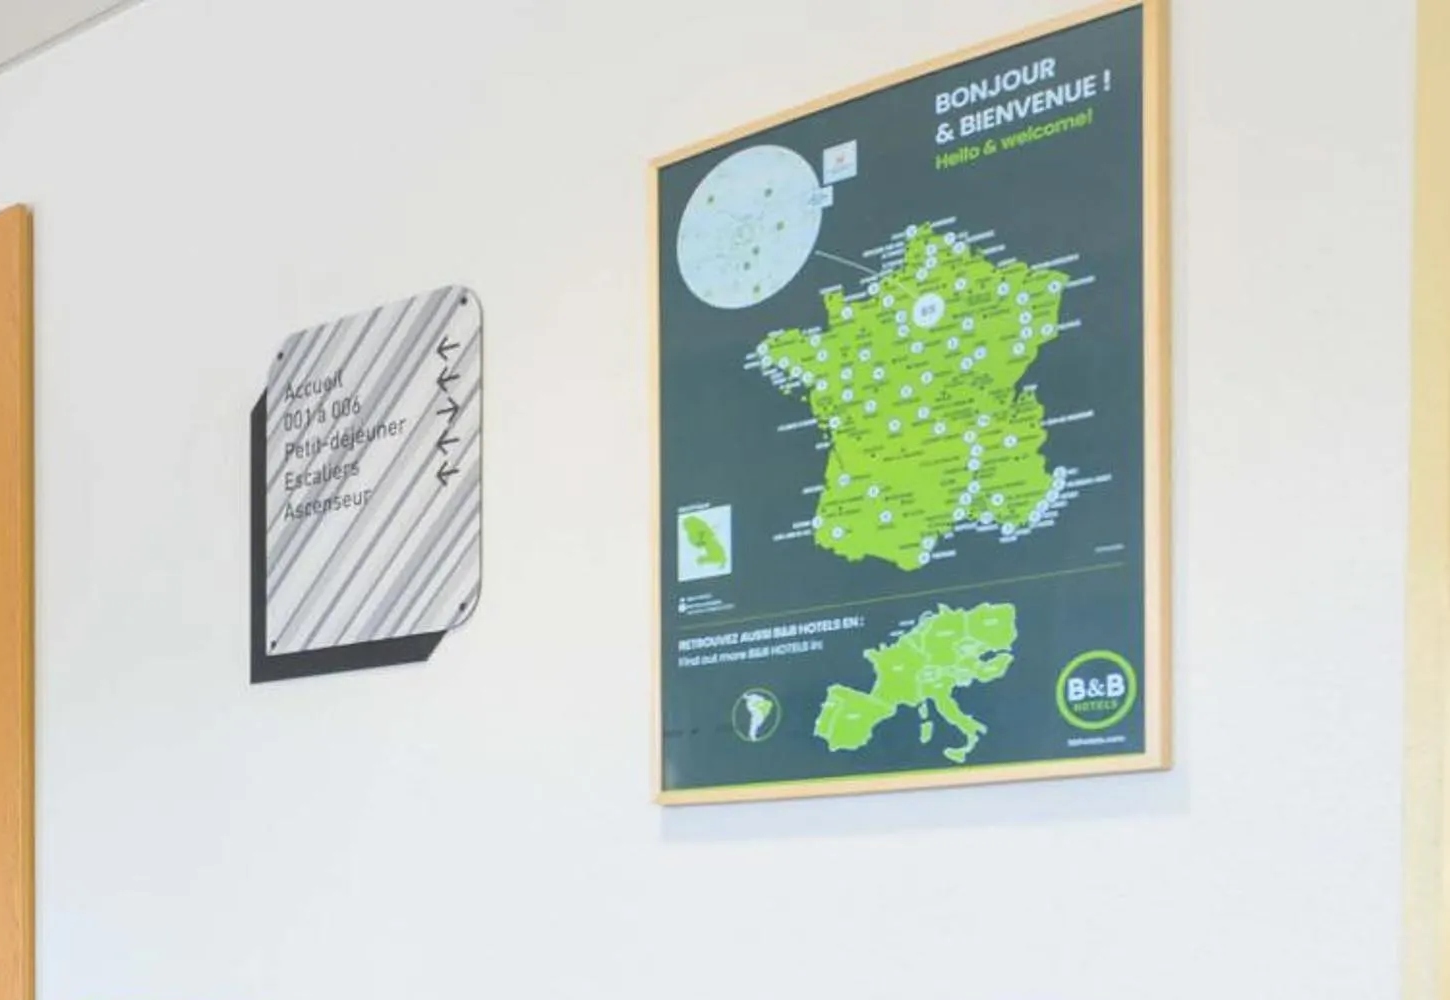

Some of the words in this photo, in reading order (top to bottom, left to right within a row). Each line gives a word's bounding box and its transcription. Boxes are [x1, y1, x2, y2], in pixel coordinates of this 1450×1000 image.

[935, 57, 1056, 114] BONJOUR
[935, 122, 955, 144] &
[959, 74, 1098, 137] BIENVENUE
[935, 146, 980, 170] Hello
[983, 139, 997, 156] &
[1002, 107, 1094, 150] welcome!
[285, 368, 344, 401] Accueil
[284, 461, 360, 491] Escaliers
[284, 489, 372, 521] Ascenseur
[1068, 673, 1125, 701] B&B
